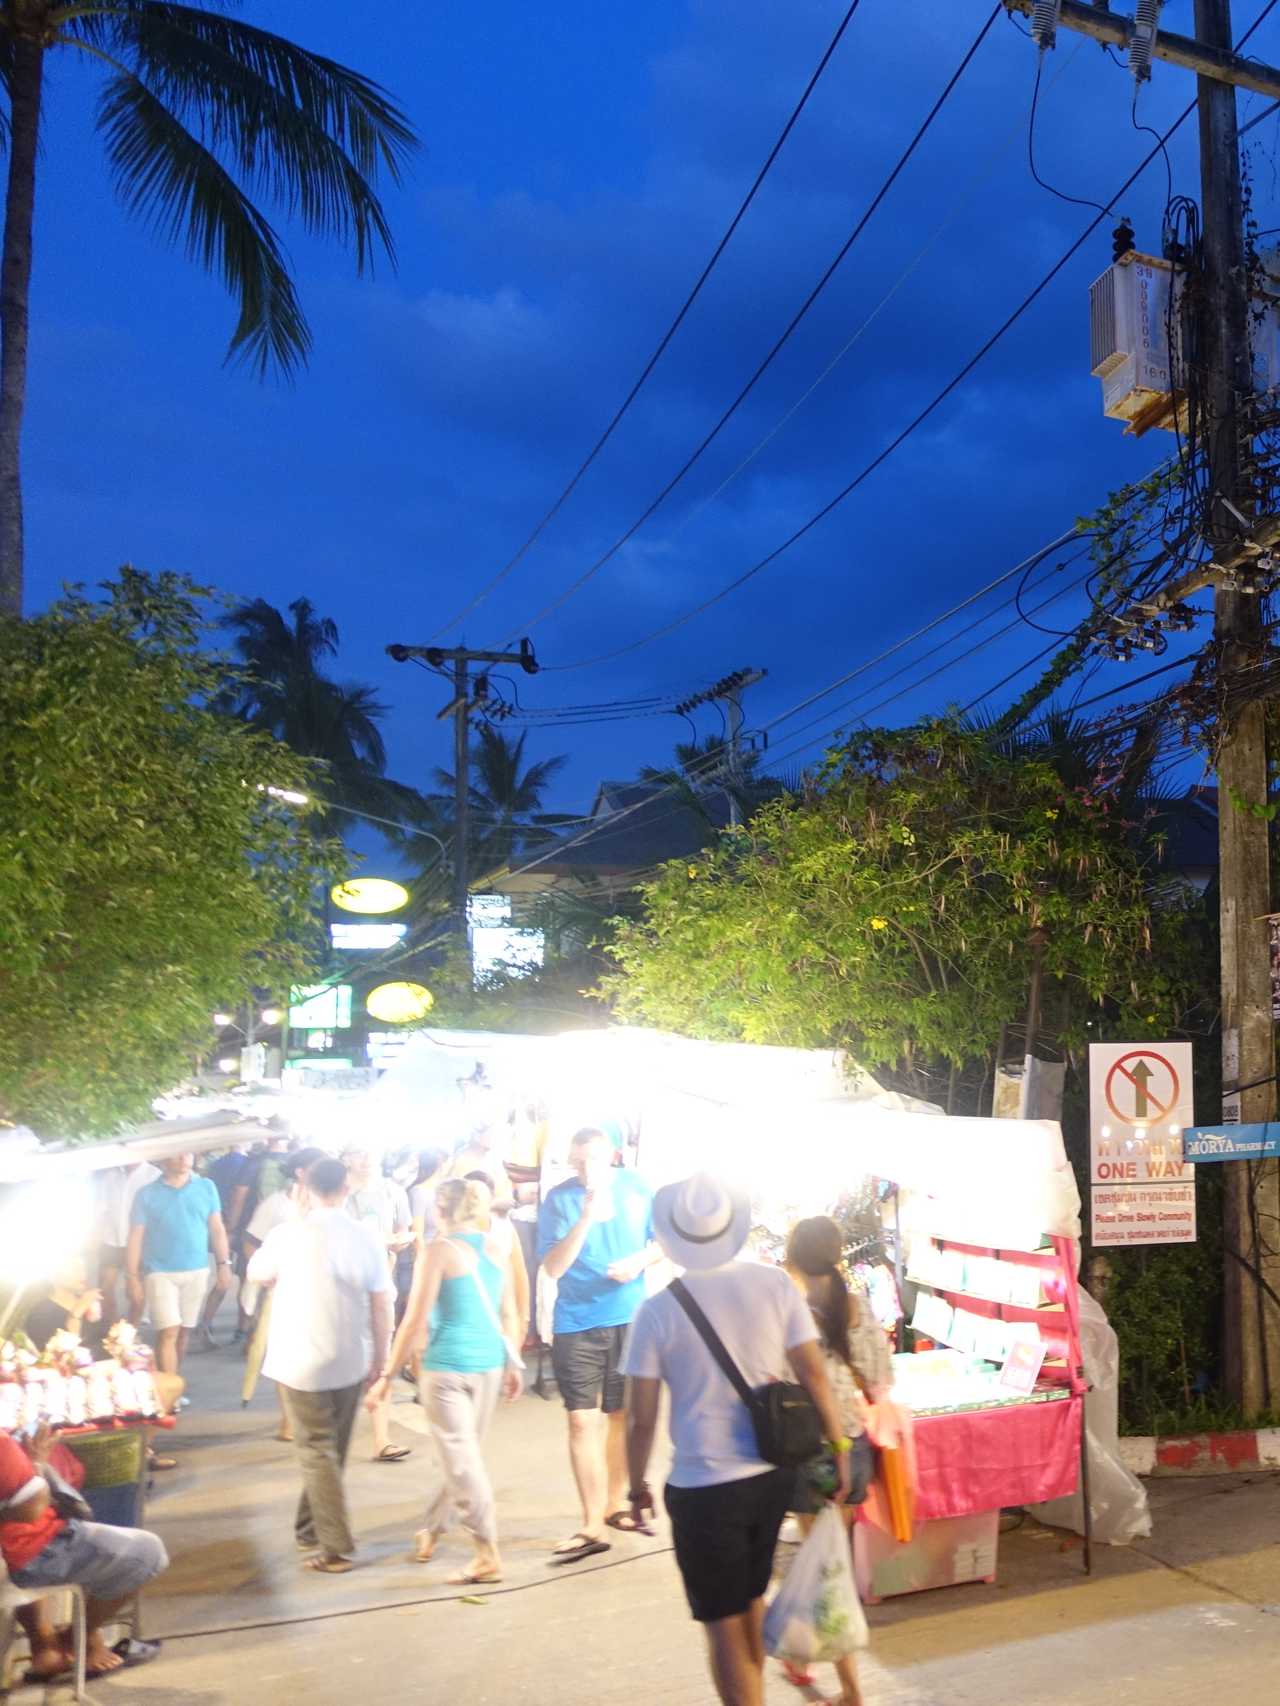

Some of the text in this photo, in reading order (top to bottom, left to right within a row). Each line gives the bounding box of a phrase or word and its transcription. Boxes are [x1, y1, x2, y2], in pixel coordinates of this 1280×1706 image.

[1188, 1139, 1234, 1155] MORYA
[1097, 1160, 1185, 1179] ONE WAY
[1095, 1211, 1192, 1223] Please Drive Slowly Community
